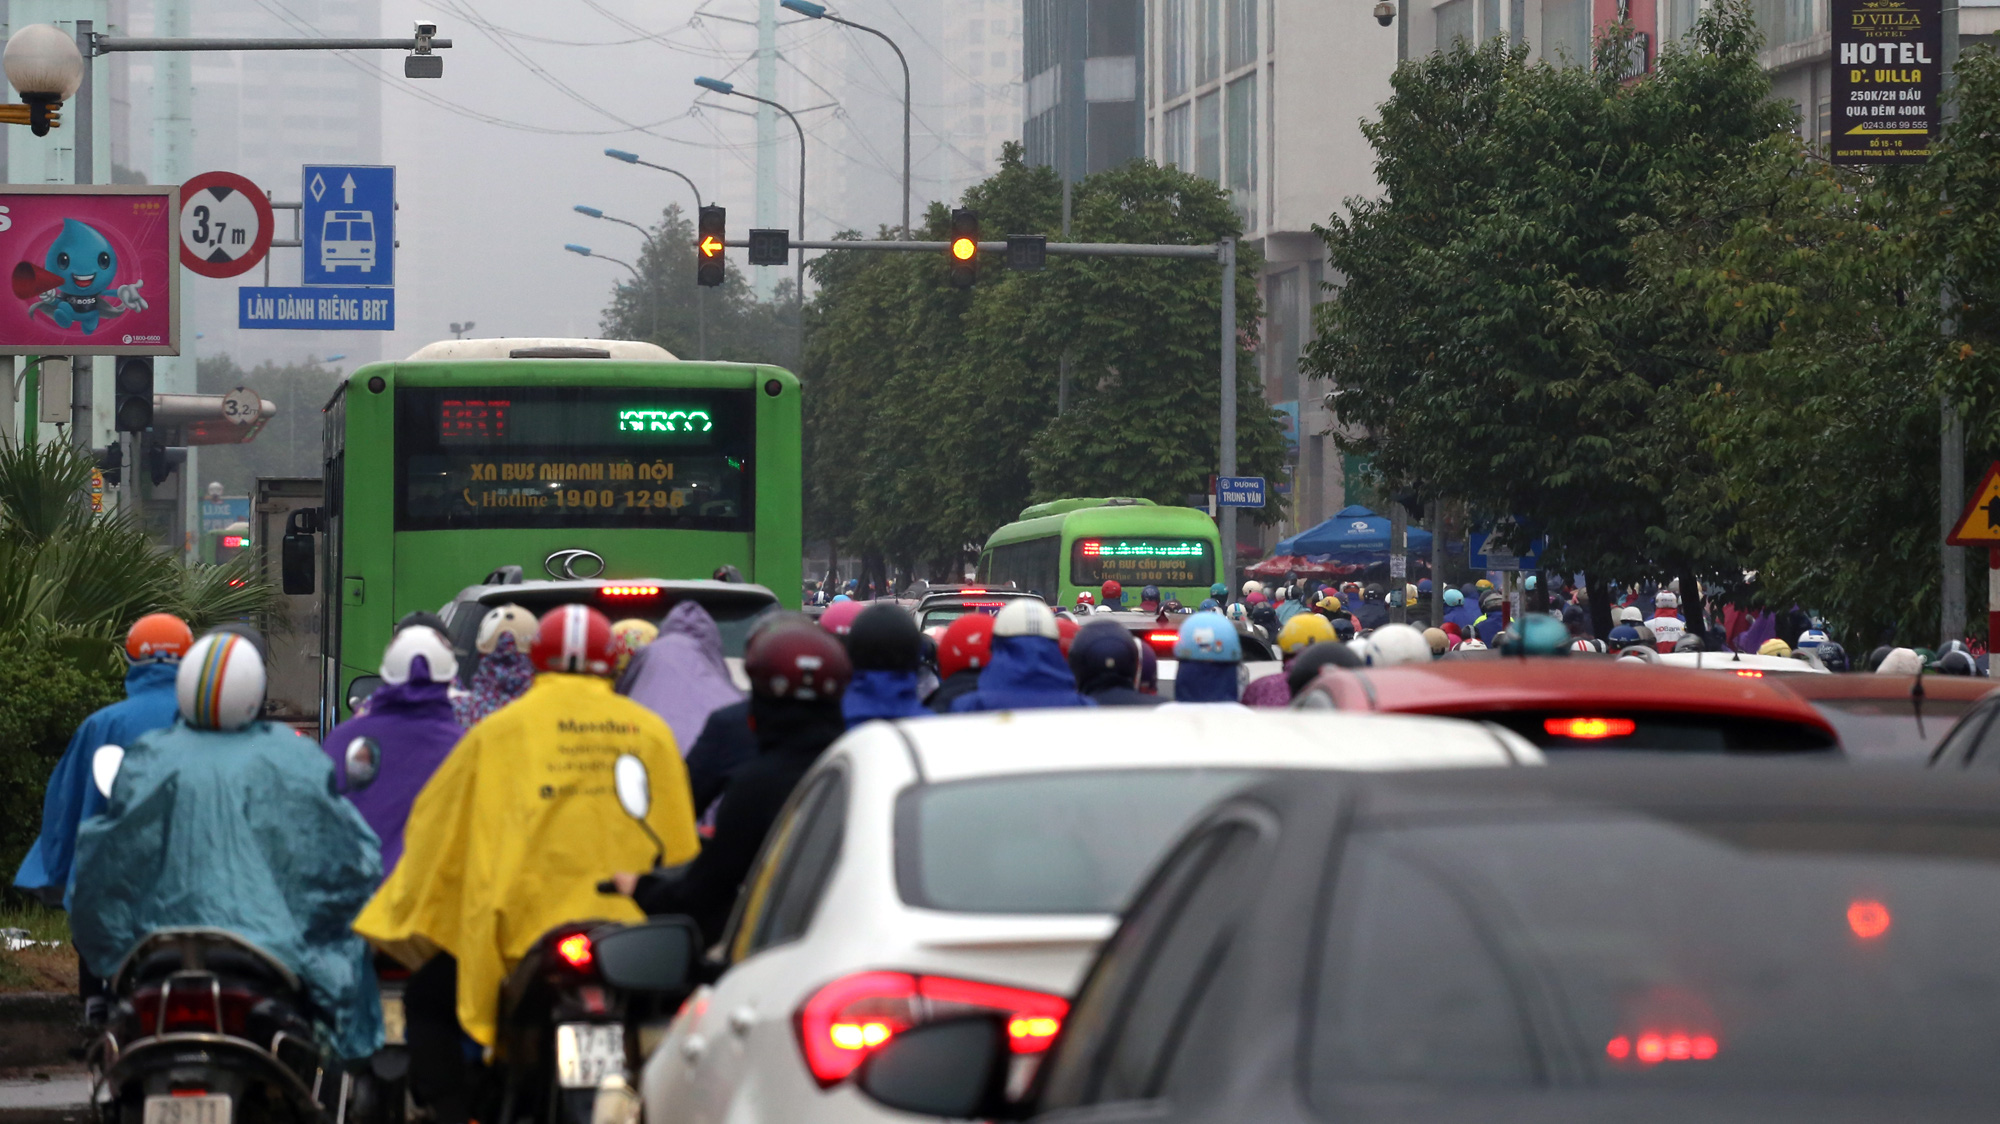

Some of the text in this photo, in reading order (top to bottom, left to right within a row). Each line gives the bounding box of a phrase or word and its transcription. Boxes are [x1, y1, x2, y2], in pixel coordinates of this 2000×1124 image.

[1840, 43, 1931, 64] HOTEL
[1851, 91, 1896, 100] 250K/2H
[1846, 104, 1925, 117] QUA ĐÊM 400K
[1899, 121, 1910, 129] 99
[1912, 121, 1928, 129] 555
[248, 293, 388, 320] LÀN DÀNH RIÊNG BRT
[501, 463, 535, 480] BUS
[539, 463, 604, 480] NHANH
[483, 490, 683, 507] Hotline 1900 1296
[1223, 491, 1246, 502] TRUNG
